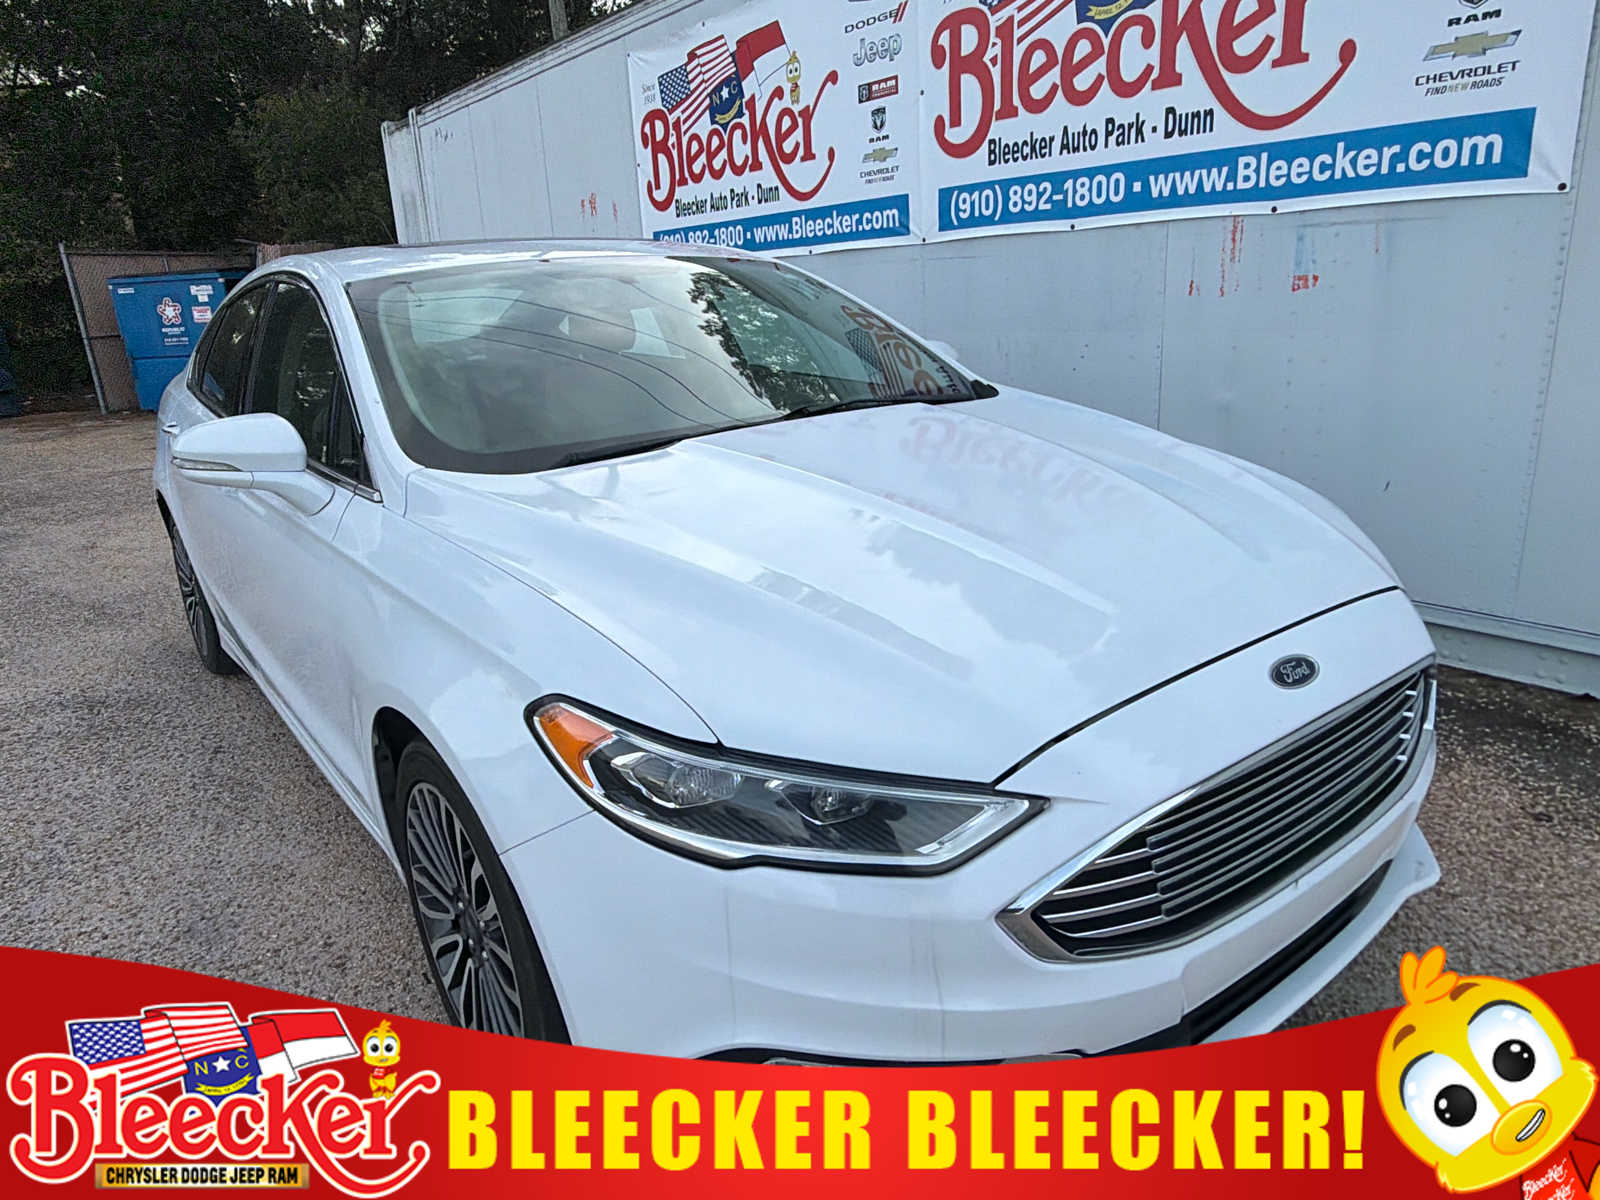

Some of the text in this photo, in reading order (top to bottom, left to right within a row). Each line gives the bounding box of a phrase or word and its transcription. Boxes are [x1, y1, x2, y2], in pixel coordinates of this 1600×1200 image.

[845, 8, 898, 33] DODGE
[1447, 9, 1502, 27] RAM
[853, 33, 902, 66] Jeep
[872, 79, 896, 91] RAM
[1415, 60, 1521, 86] CHEVROLET
[1469, 76, 1505, 91] ROADS
[641, 70, 838, 212] Bleecker
[869, 134, 889, 144] RAM
[987, 131, 1055, 167] Bleecker
[1059, 122, 1099, 156] Auto
[1104, 112, 1146, 148] Park
[1164, 106, 1214, 140] Dunn
[951, 133, 1504, 225] (910) 892-1800 www.Bleecker.com
[675, 195, 708, 218] Bleecker
[710, 192, 728, 212] Auto
[730, 185, 750, 209] Park
[757, 183, 780, 204] Dunn
[753, 208, 899, 243] www.Bleecker.com
[1280, 661, 1311, 683] Ford
